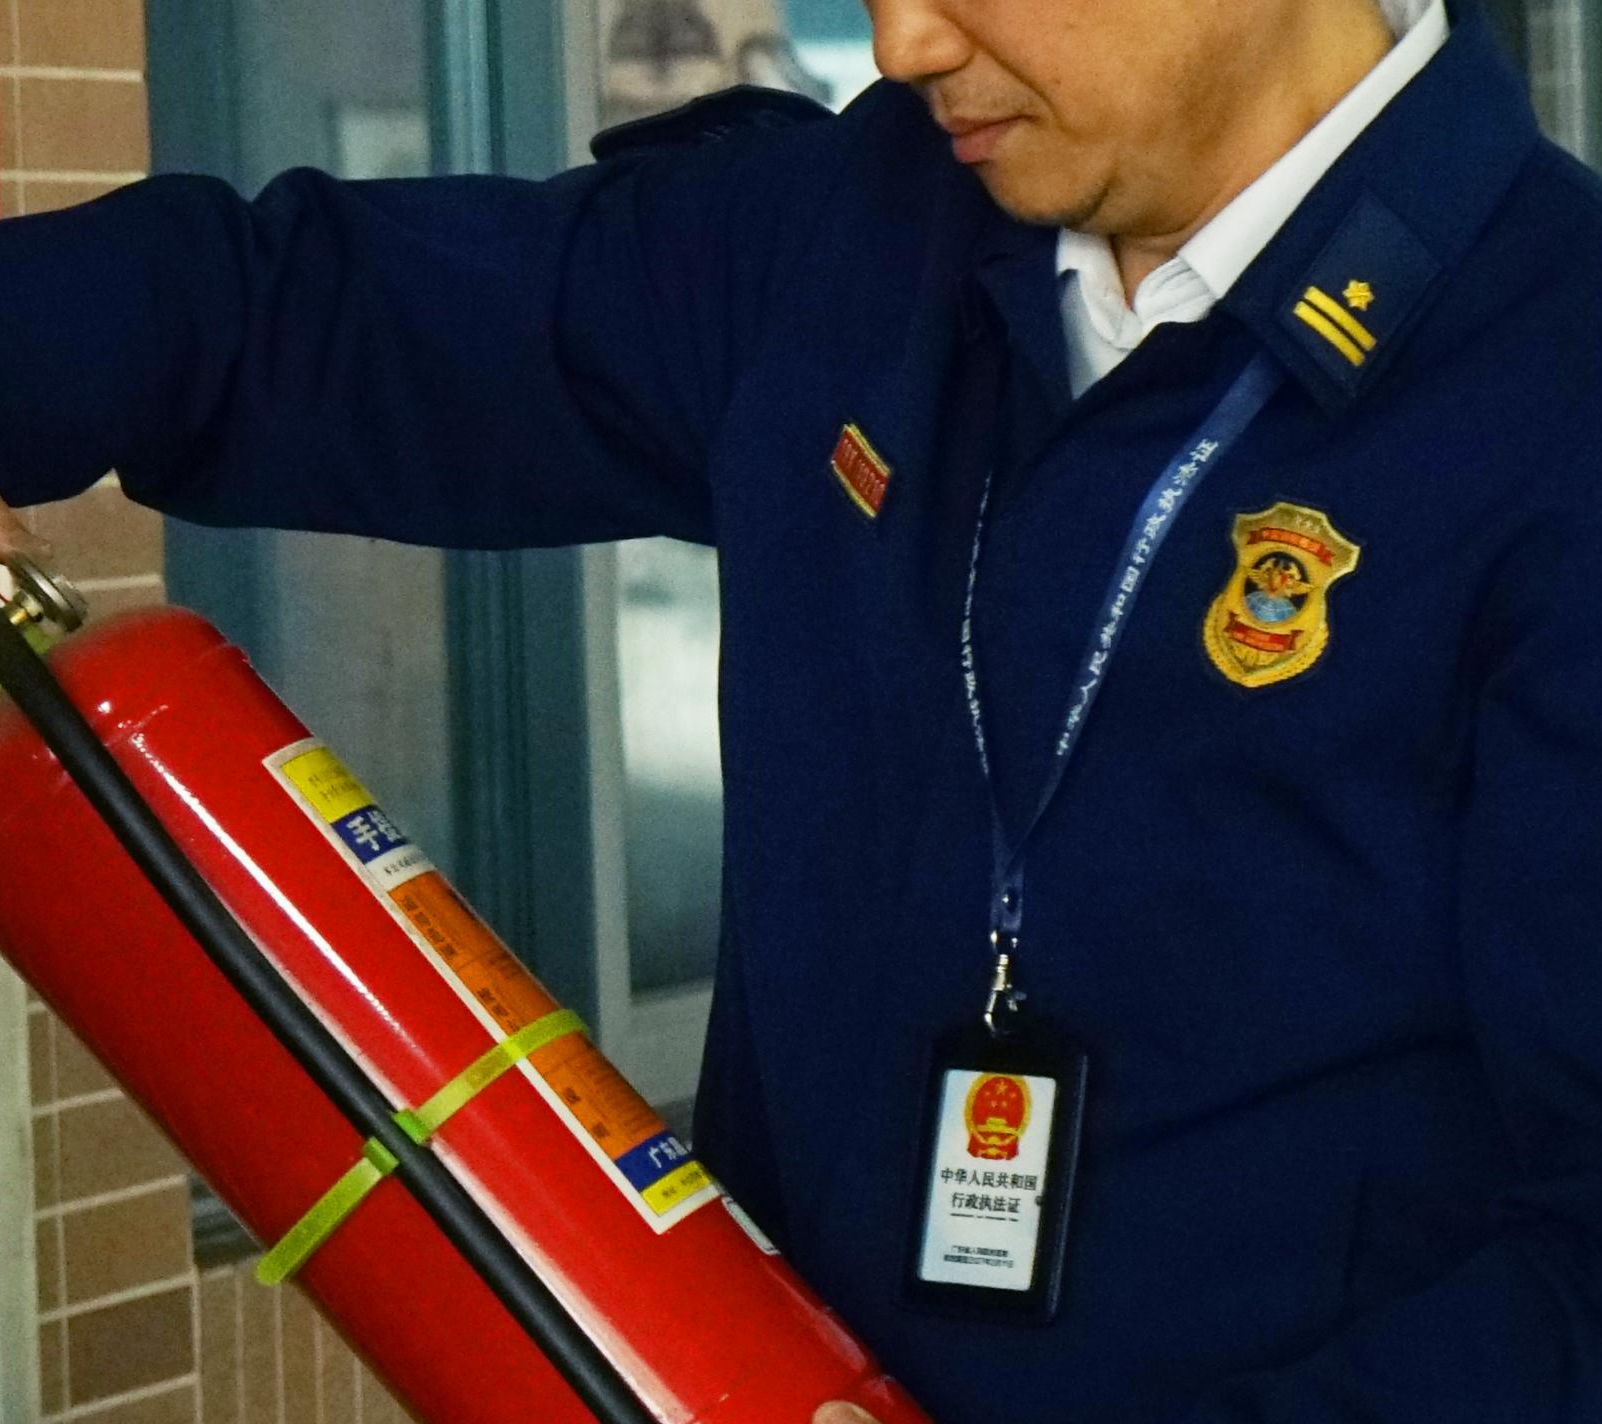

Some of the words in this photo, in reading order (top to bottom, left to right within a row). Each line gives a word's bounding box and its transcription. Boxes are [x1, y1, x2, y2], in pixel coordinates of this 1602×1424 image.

[940, 1167, 1038, 1191] 中华人民共和国
[951, 1191, 1022, 1214] 行政执法证
